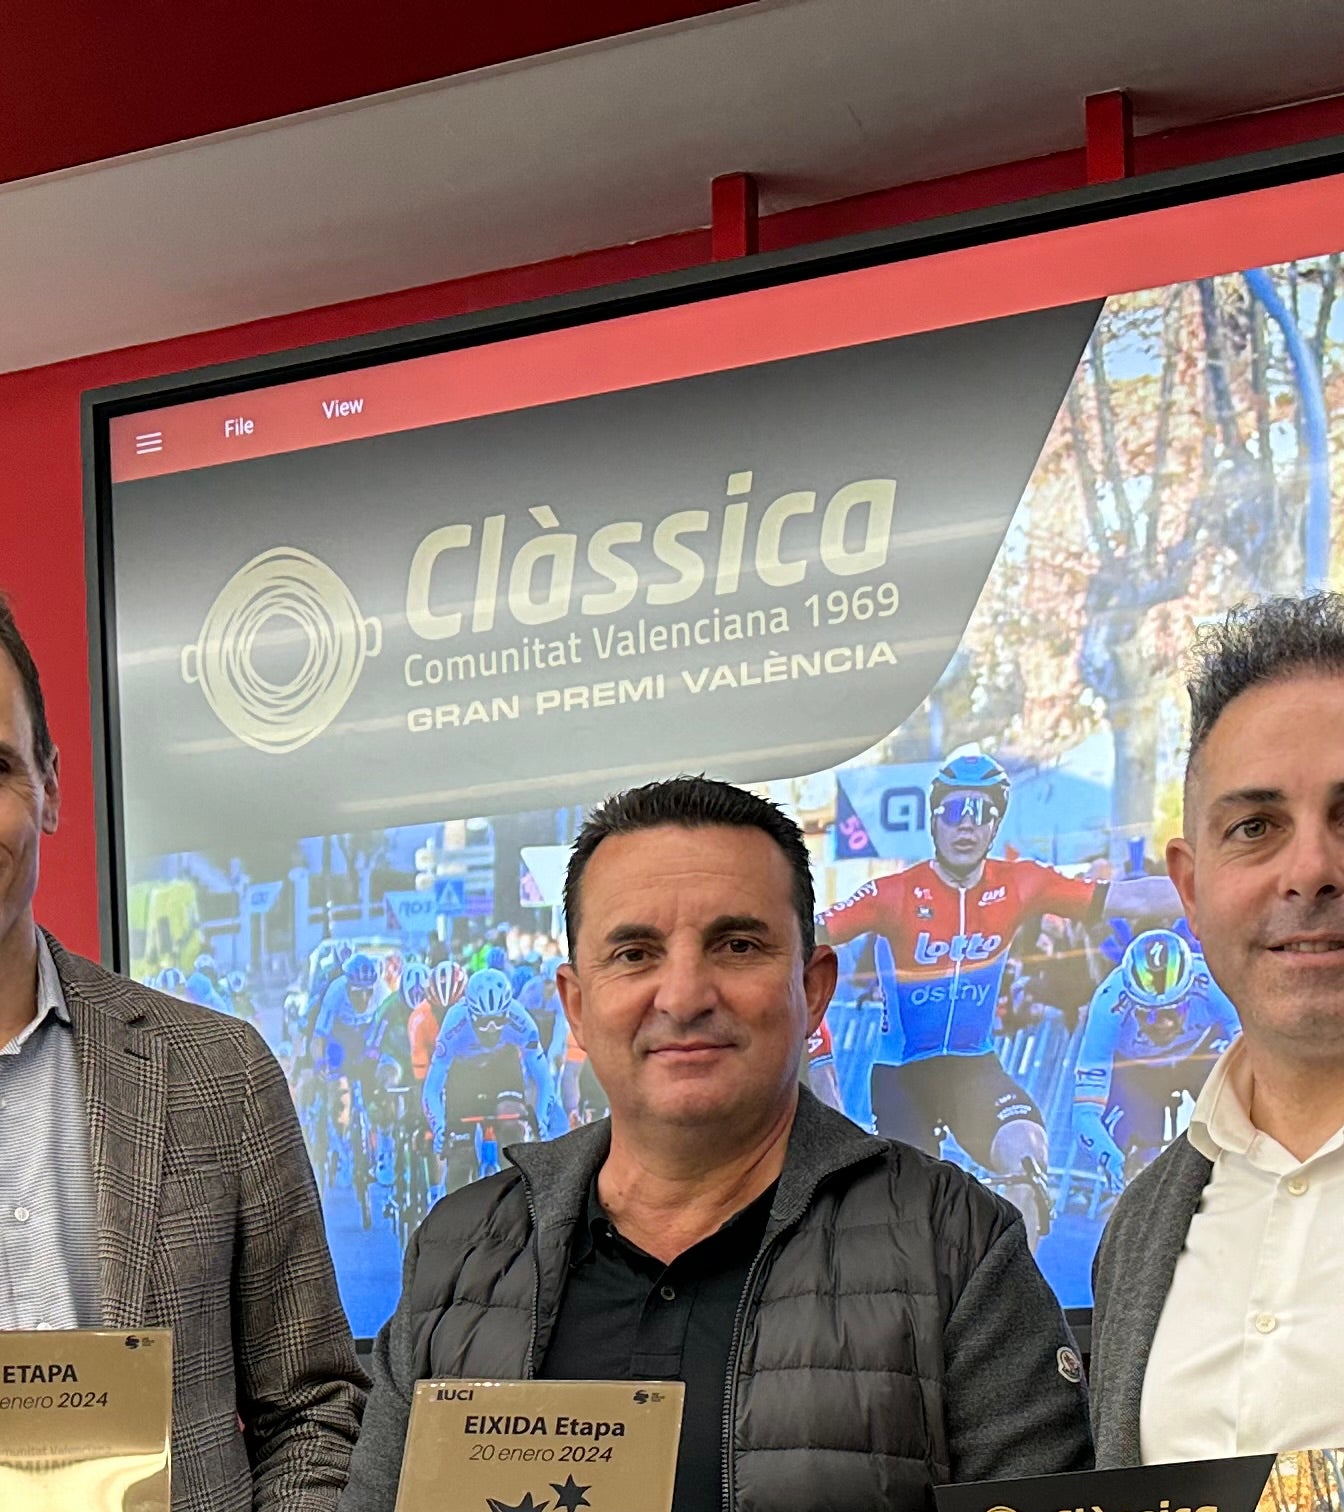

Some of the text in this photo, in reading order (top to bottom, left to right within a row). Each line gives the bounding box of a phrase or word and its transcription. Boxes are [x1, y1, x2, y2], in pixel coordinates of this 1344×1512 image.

[322, 397, 364, 420] View
[225, 417, 254, 438] File
[405, 470, 897, 640] Clàssica
[404, 581, 900, 687] Comunitat Valenciana 1969
[406, 640, 898, 733] GRAN PREMI VALÈNCIA
[2, 1364, 78, 1384] ETAPA
[0, 1395, 53, 1410] enero
[57, 1392, 109, 1409] 2024
[464, 1415, 626, 1441] EIXIDA Etapa
[468, 1444, 613, 1463] 20 enero 2024
